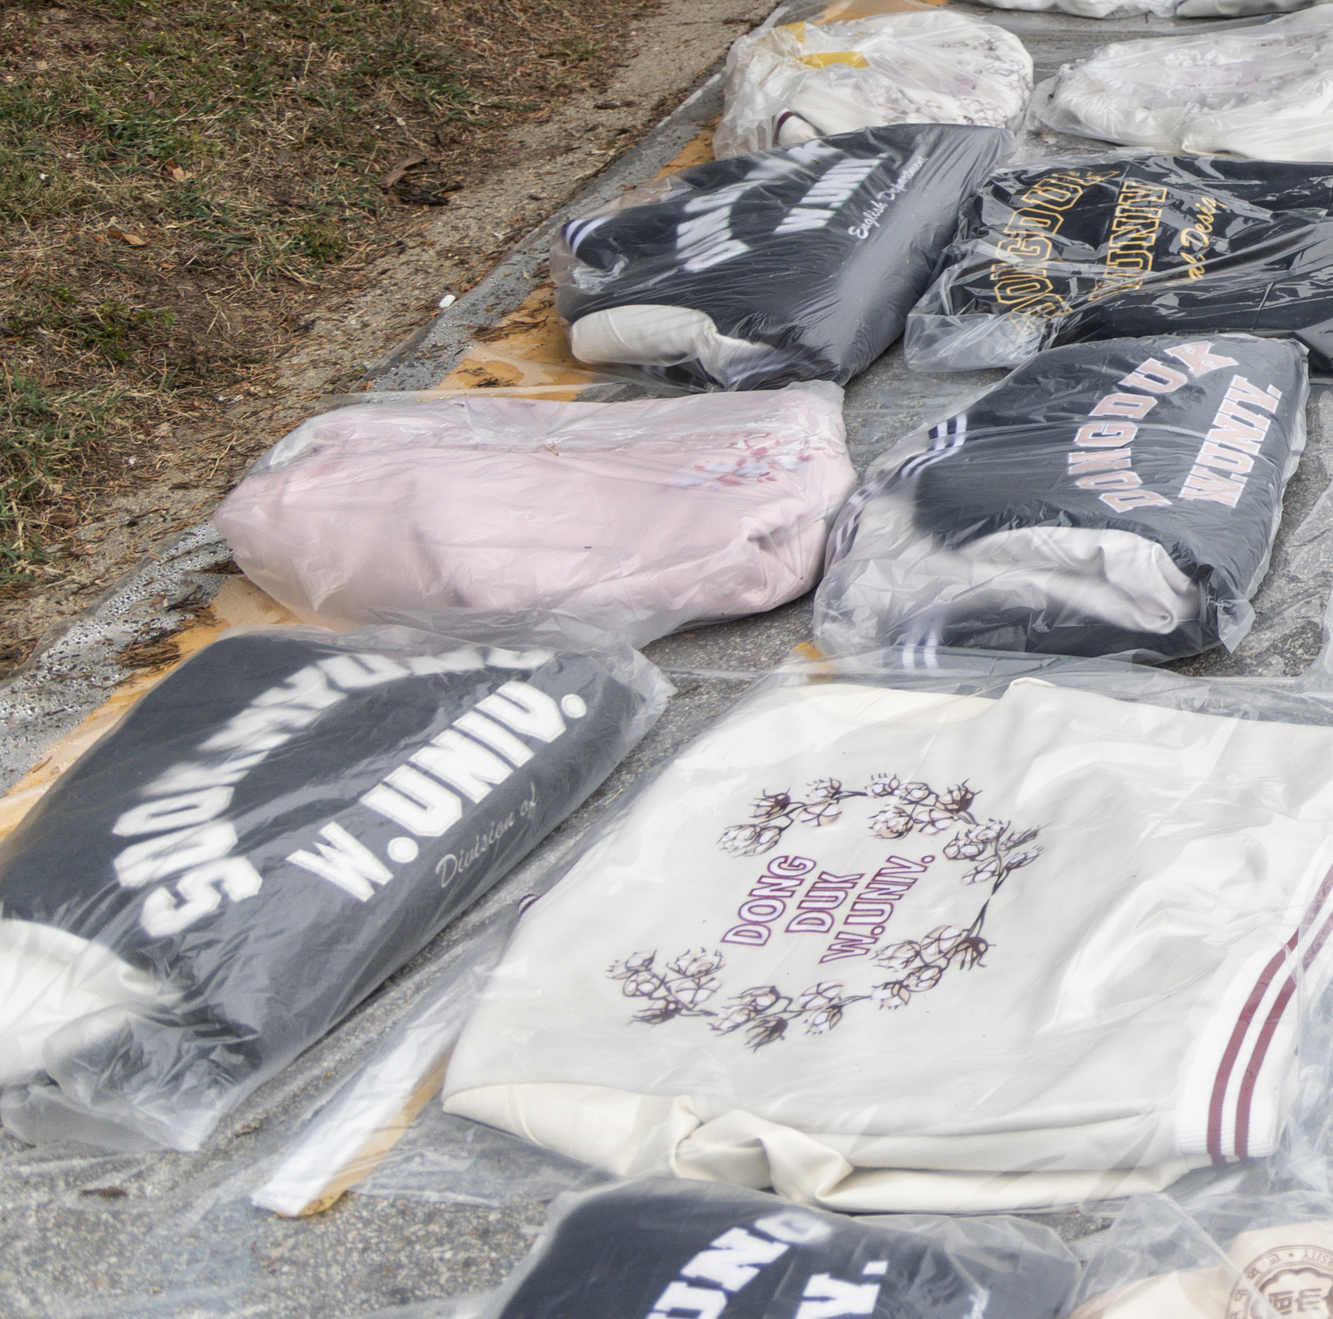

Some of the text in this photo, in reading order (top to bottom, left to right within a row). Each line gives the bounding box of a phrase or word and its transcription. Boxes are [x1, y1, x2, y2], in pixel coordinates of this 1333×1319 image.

[848, 200, 889, 240] English
[1067, 340, 1240, 514] DONGDUK
[1177, 373, 1283, 509] W.UNIV.
[285, 679, 587, 903] W.UNIV.
[434, 811, 517, 889] Division
[720, 854, 818, 947] DONG
[784, 870, 866, 934] DUK
[818, 853, 937, 965] W.UNIV.
